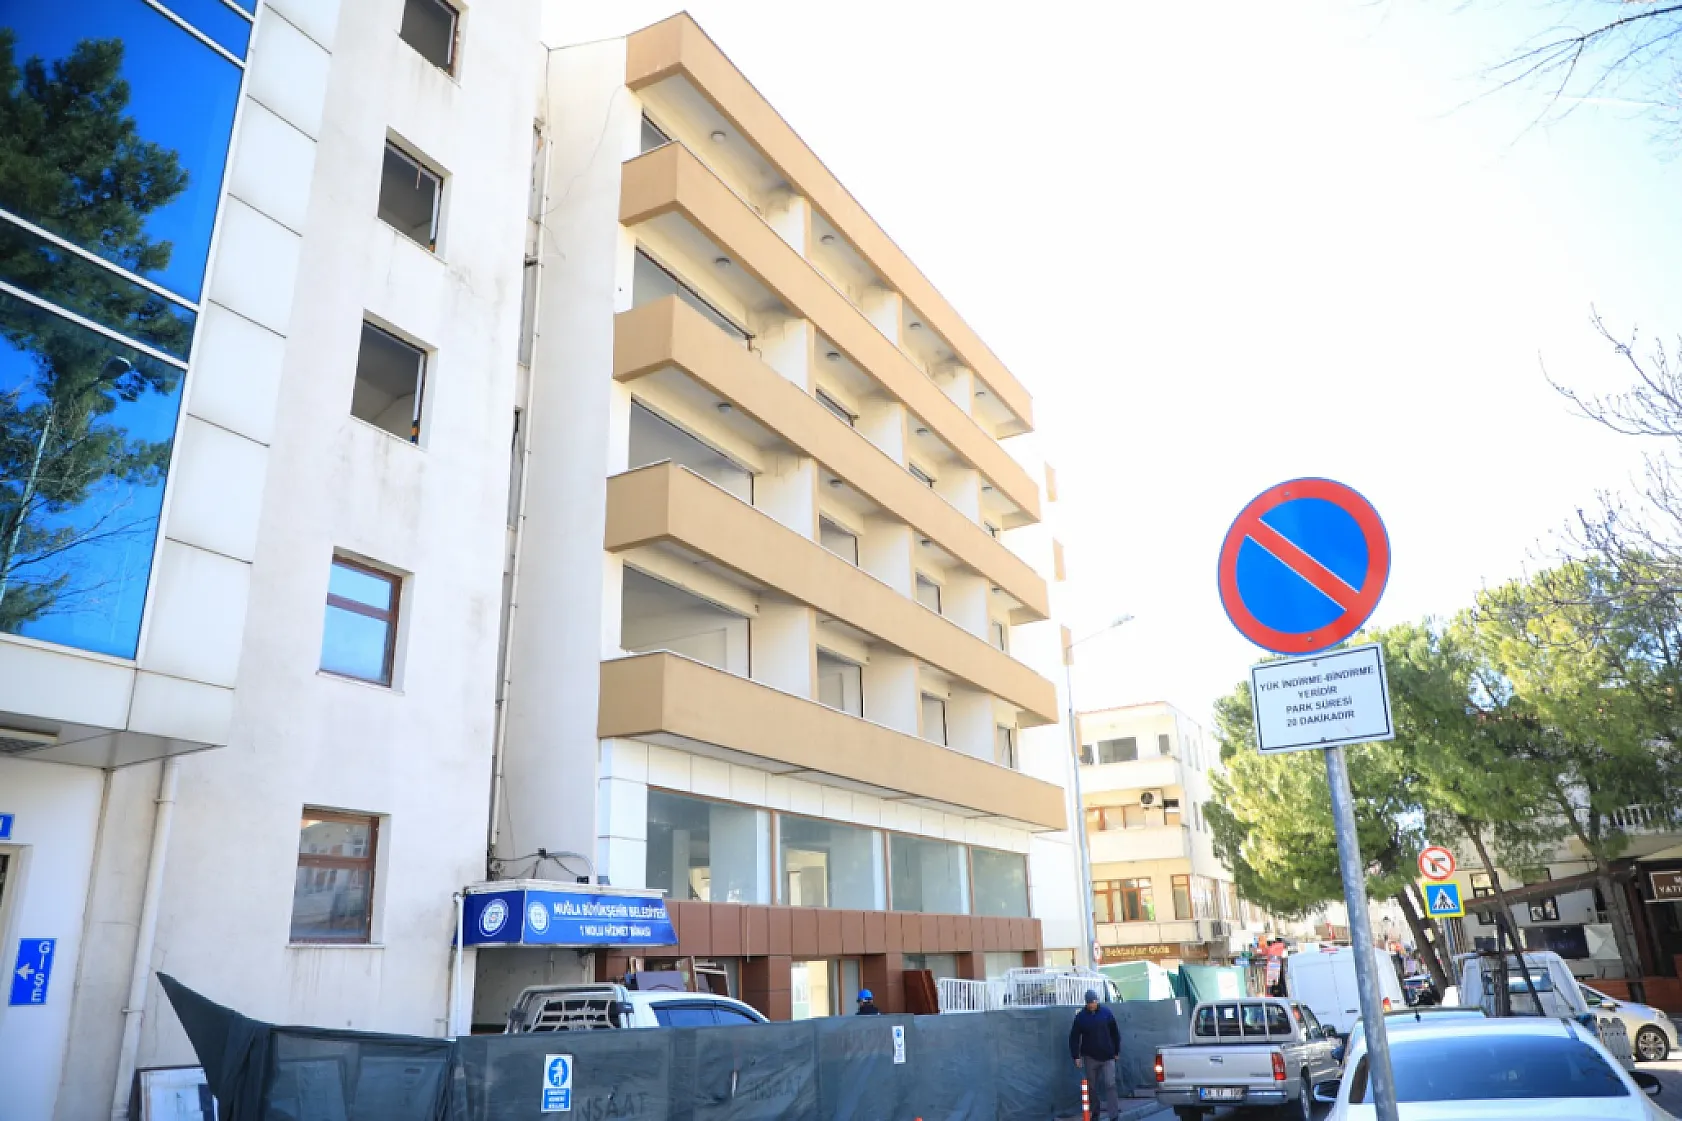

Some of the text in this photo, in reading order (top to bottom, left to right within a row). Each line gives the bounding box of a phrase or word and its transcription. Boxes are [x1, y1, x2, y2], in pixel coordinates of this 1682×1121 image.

[1260, 681, 1280, 692] YÜK
[1298, 685, 1338, 699] YERİDİR
[1286, 696, 1352, 713] PARK SÜRESİ
[1287, 717, 1297, 727] 20
[554, 901, 581, 915] MUĞLA
[582, 902, 628, 917] BÜYÜKŞEHİR
